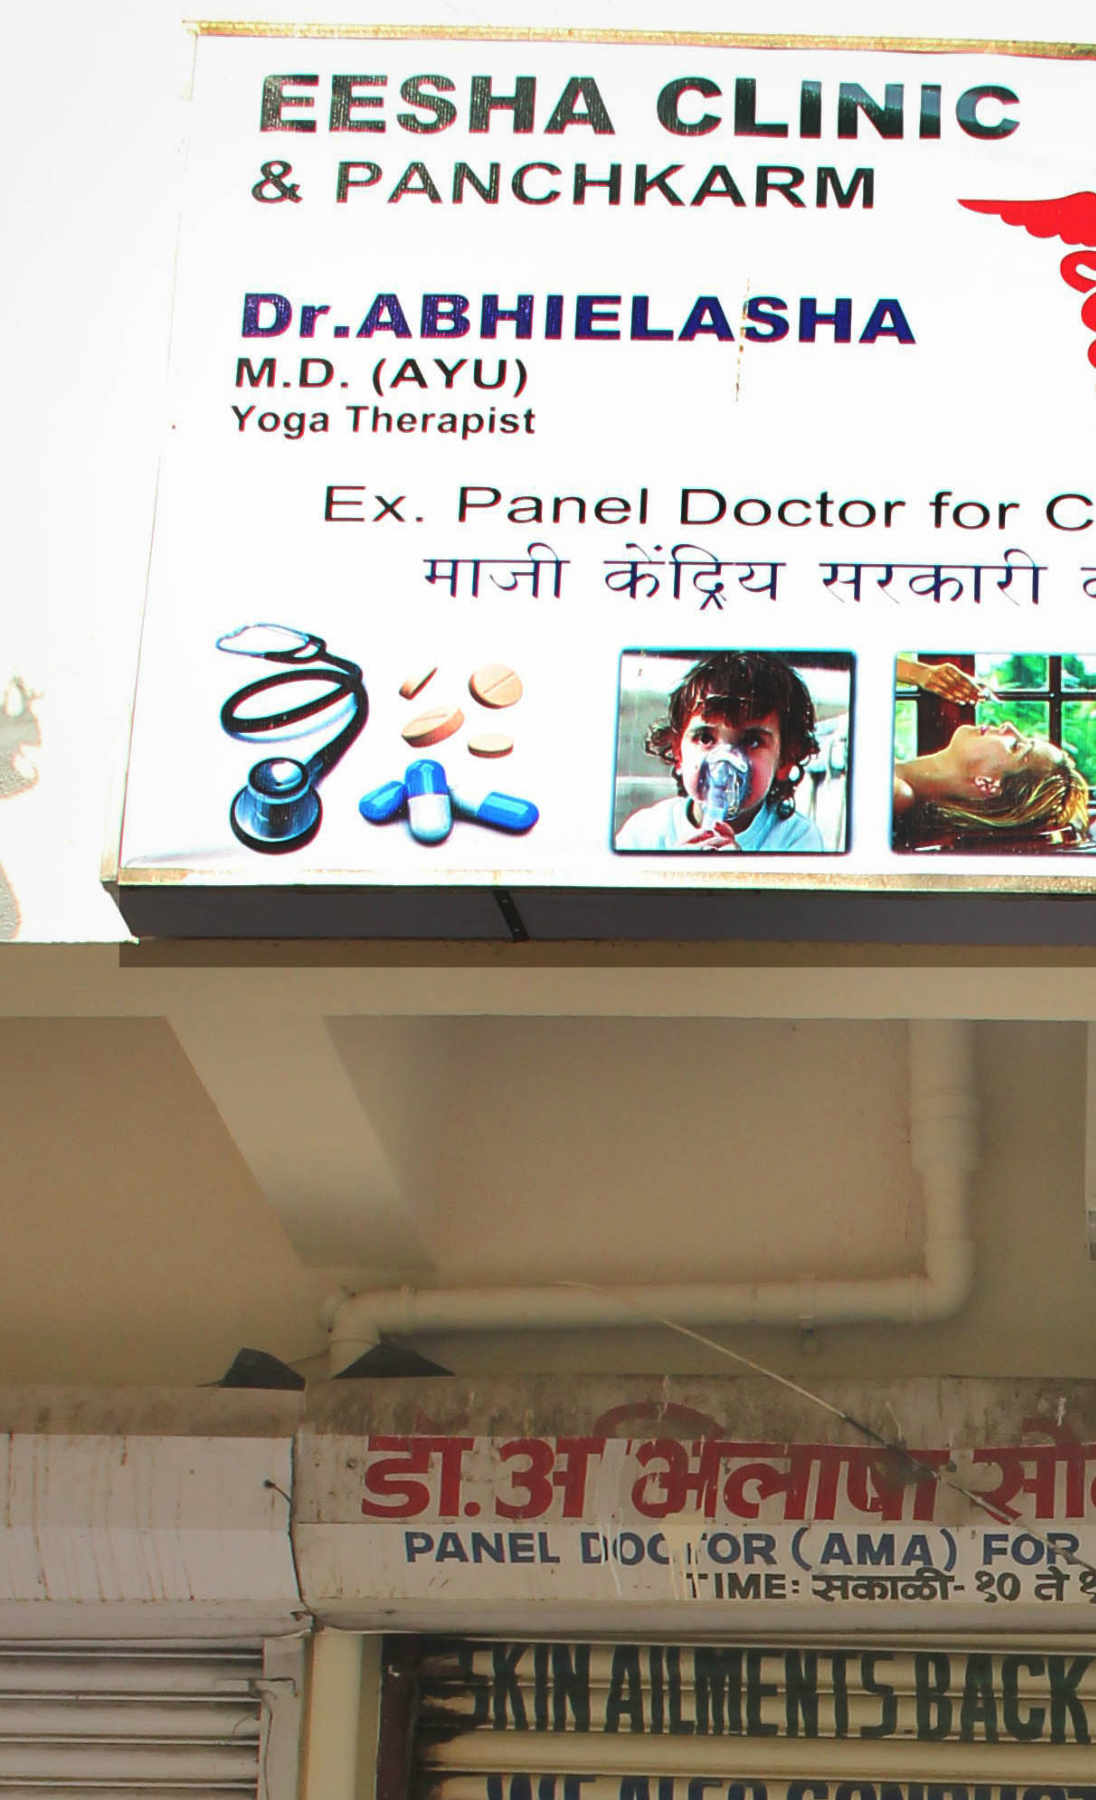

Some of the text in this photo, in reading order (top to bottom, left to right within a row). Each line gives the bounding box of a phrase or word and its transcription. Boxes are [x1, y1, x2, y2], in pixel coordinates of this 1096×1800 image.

[260, 74, 1019, 140] EESHA CLINIC
[252, 161, 874, 208] & PANCHKARM
[236, 358, 527, 396] M.D. (AYU)
[232, 406, 535, 440] Yoga Therapist
[325, 486, 423, 522] Ex.
[459, 486, 648, 524] Panel
[681, 488, 905, 528] Doctor
[930, 490, 1019, 529] for
[424, 543, 570, 598] माजी
[819, 549, 1047, 604] सरकारी
[404, 1530, 560, 1564] PANEL
[790, 1529, 958, 1573] (AMA)
[981, 1531, 1080, 1568] FOR
